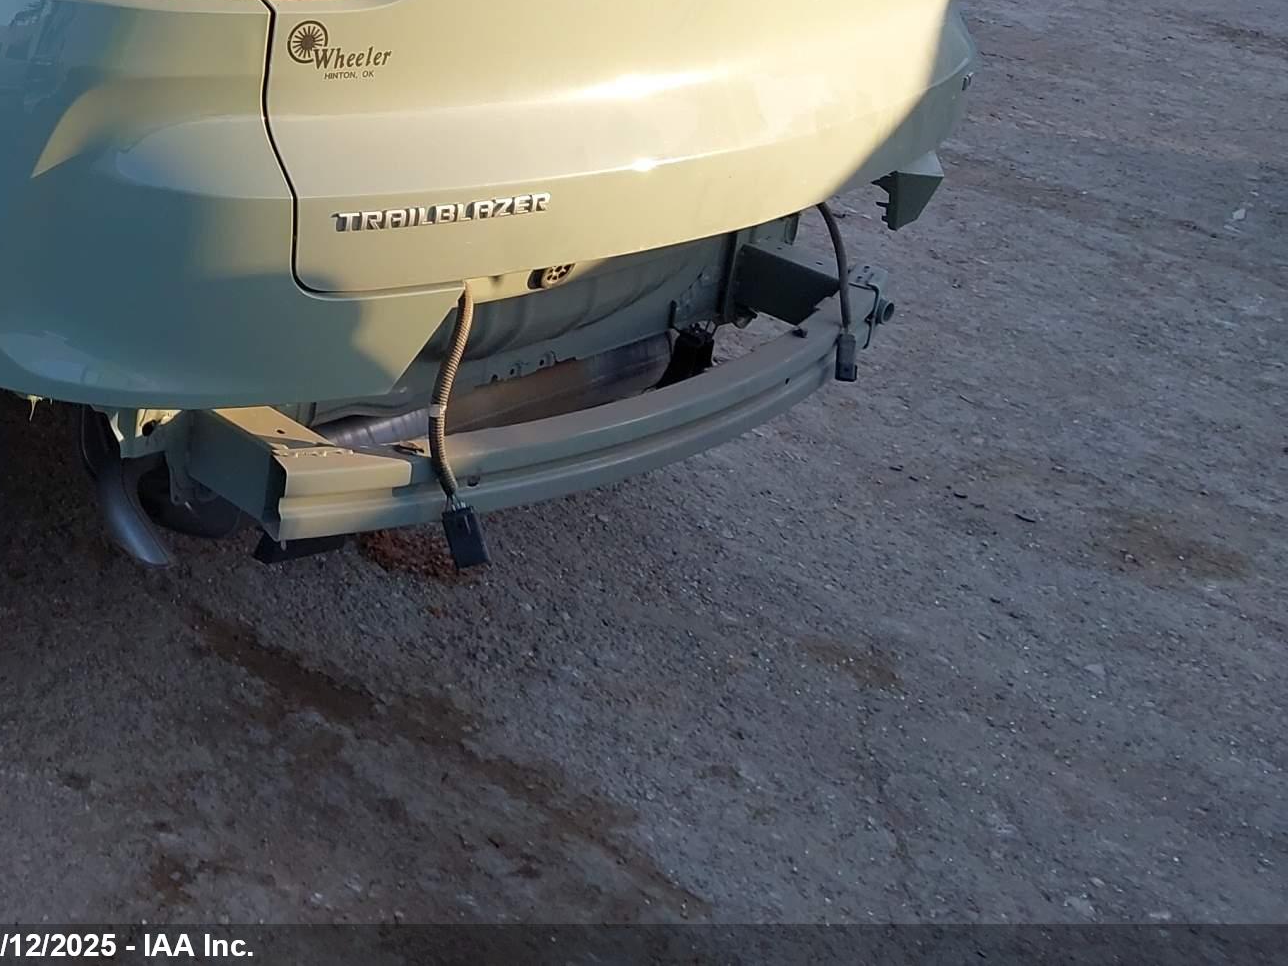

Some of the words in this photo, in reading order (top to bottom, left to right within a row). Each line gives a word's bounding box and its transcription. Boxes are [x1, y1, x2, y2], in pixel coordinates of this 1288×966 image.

[313, 46, 392, 69] Wheeler
[324, 71, 358, 80] HINTON,
[362, 70, 374, 78] OK
[331, 192, 551, 232] TRAILBLAZER
